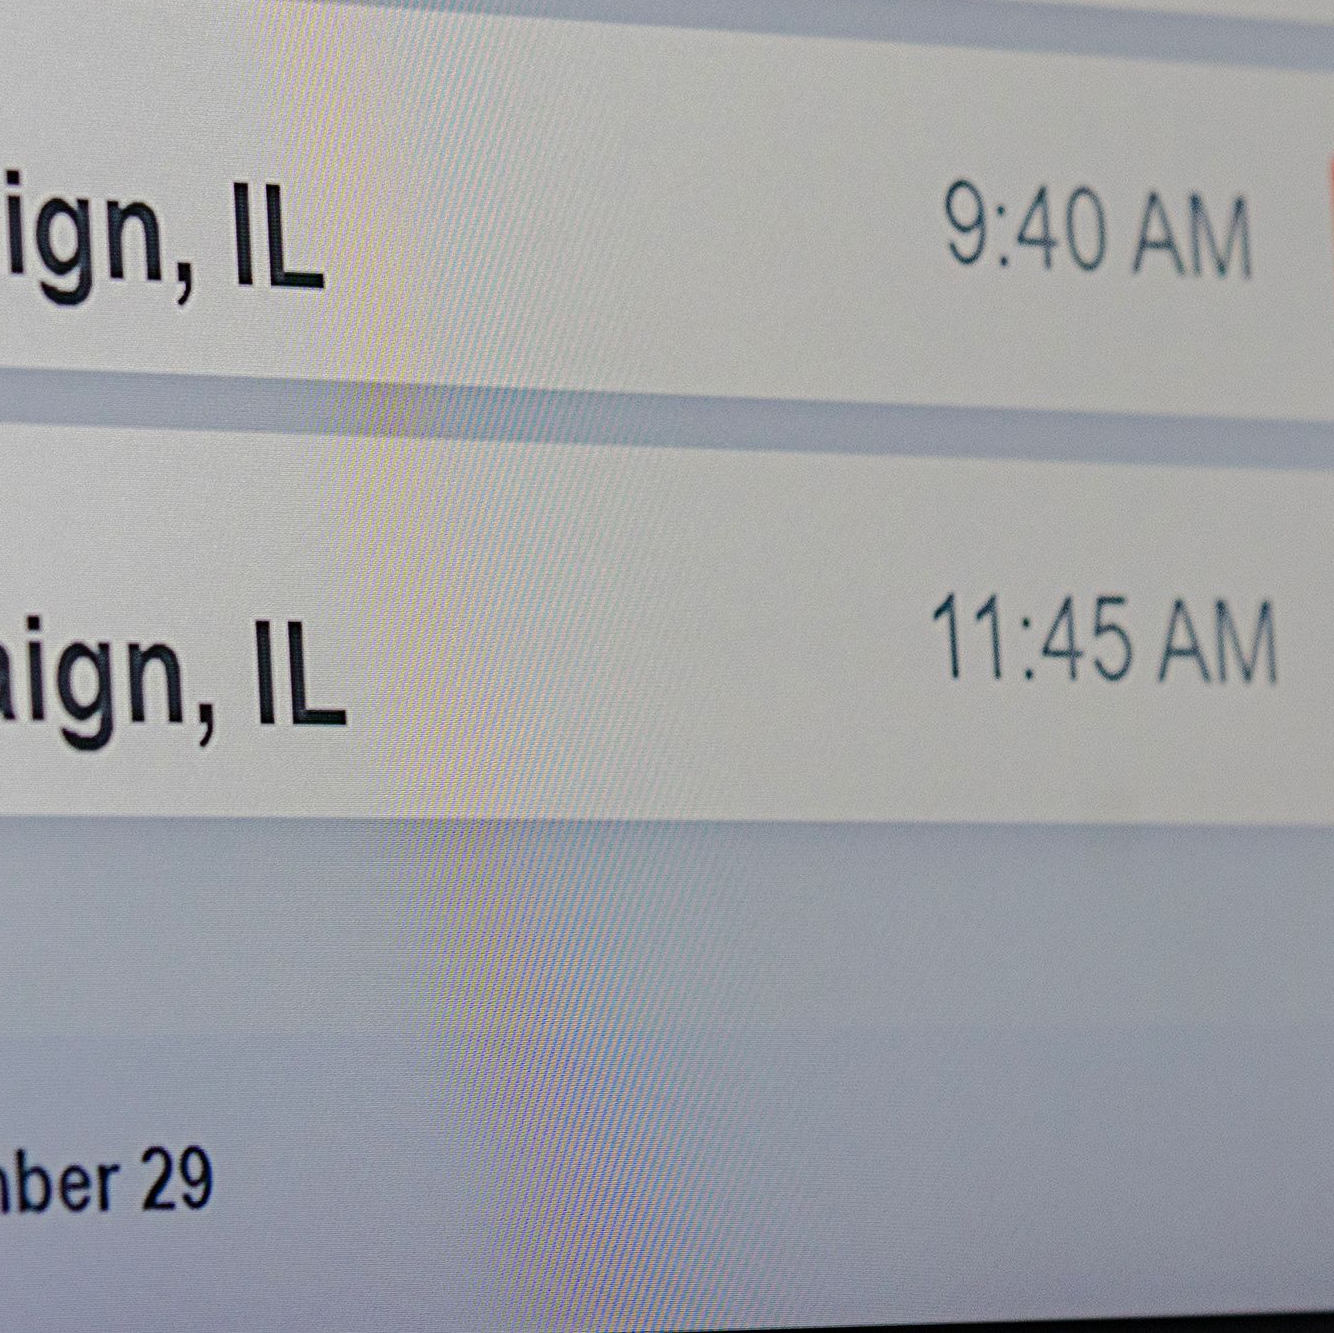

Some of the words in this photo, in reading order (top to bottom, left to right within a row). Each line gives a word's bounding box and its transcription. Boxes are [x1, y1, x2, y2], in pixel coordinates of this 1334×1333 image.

[232, 181, 326, 290] IL
[943, 177, 1107, 273] 9:40
[1131, 190, 1252, 278] AM
[254, 619, 348, 727] IL
[931, 592, 1134, 684] 11:45
[1157, 597, 1278, 684] AM
[141, 1144, 214, 1212] 29
